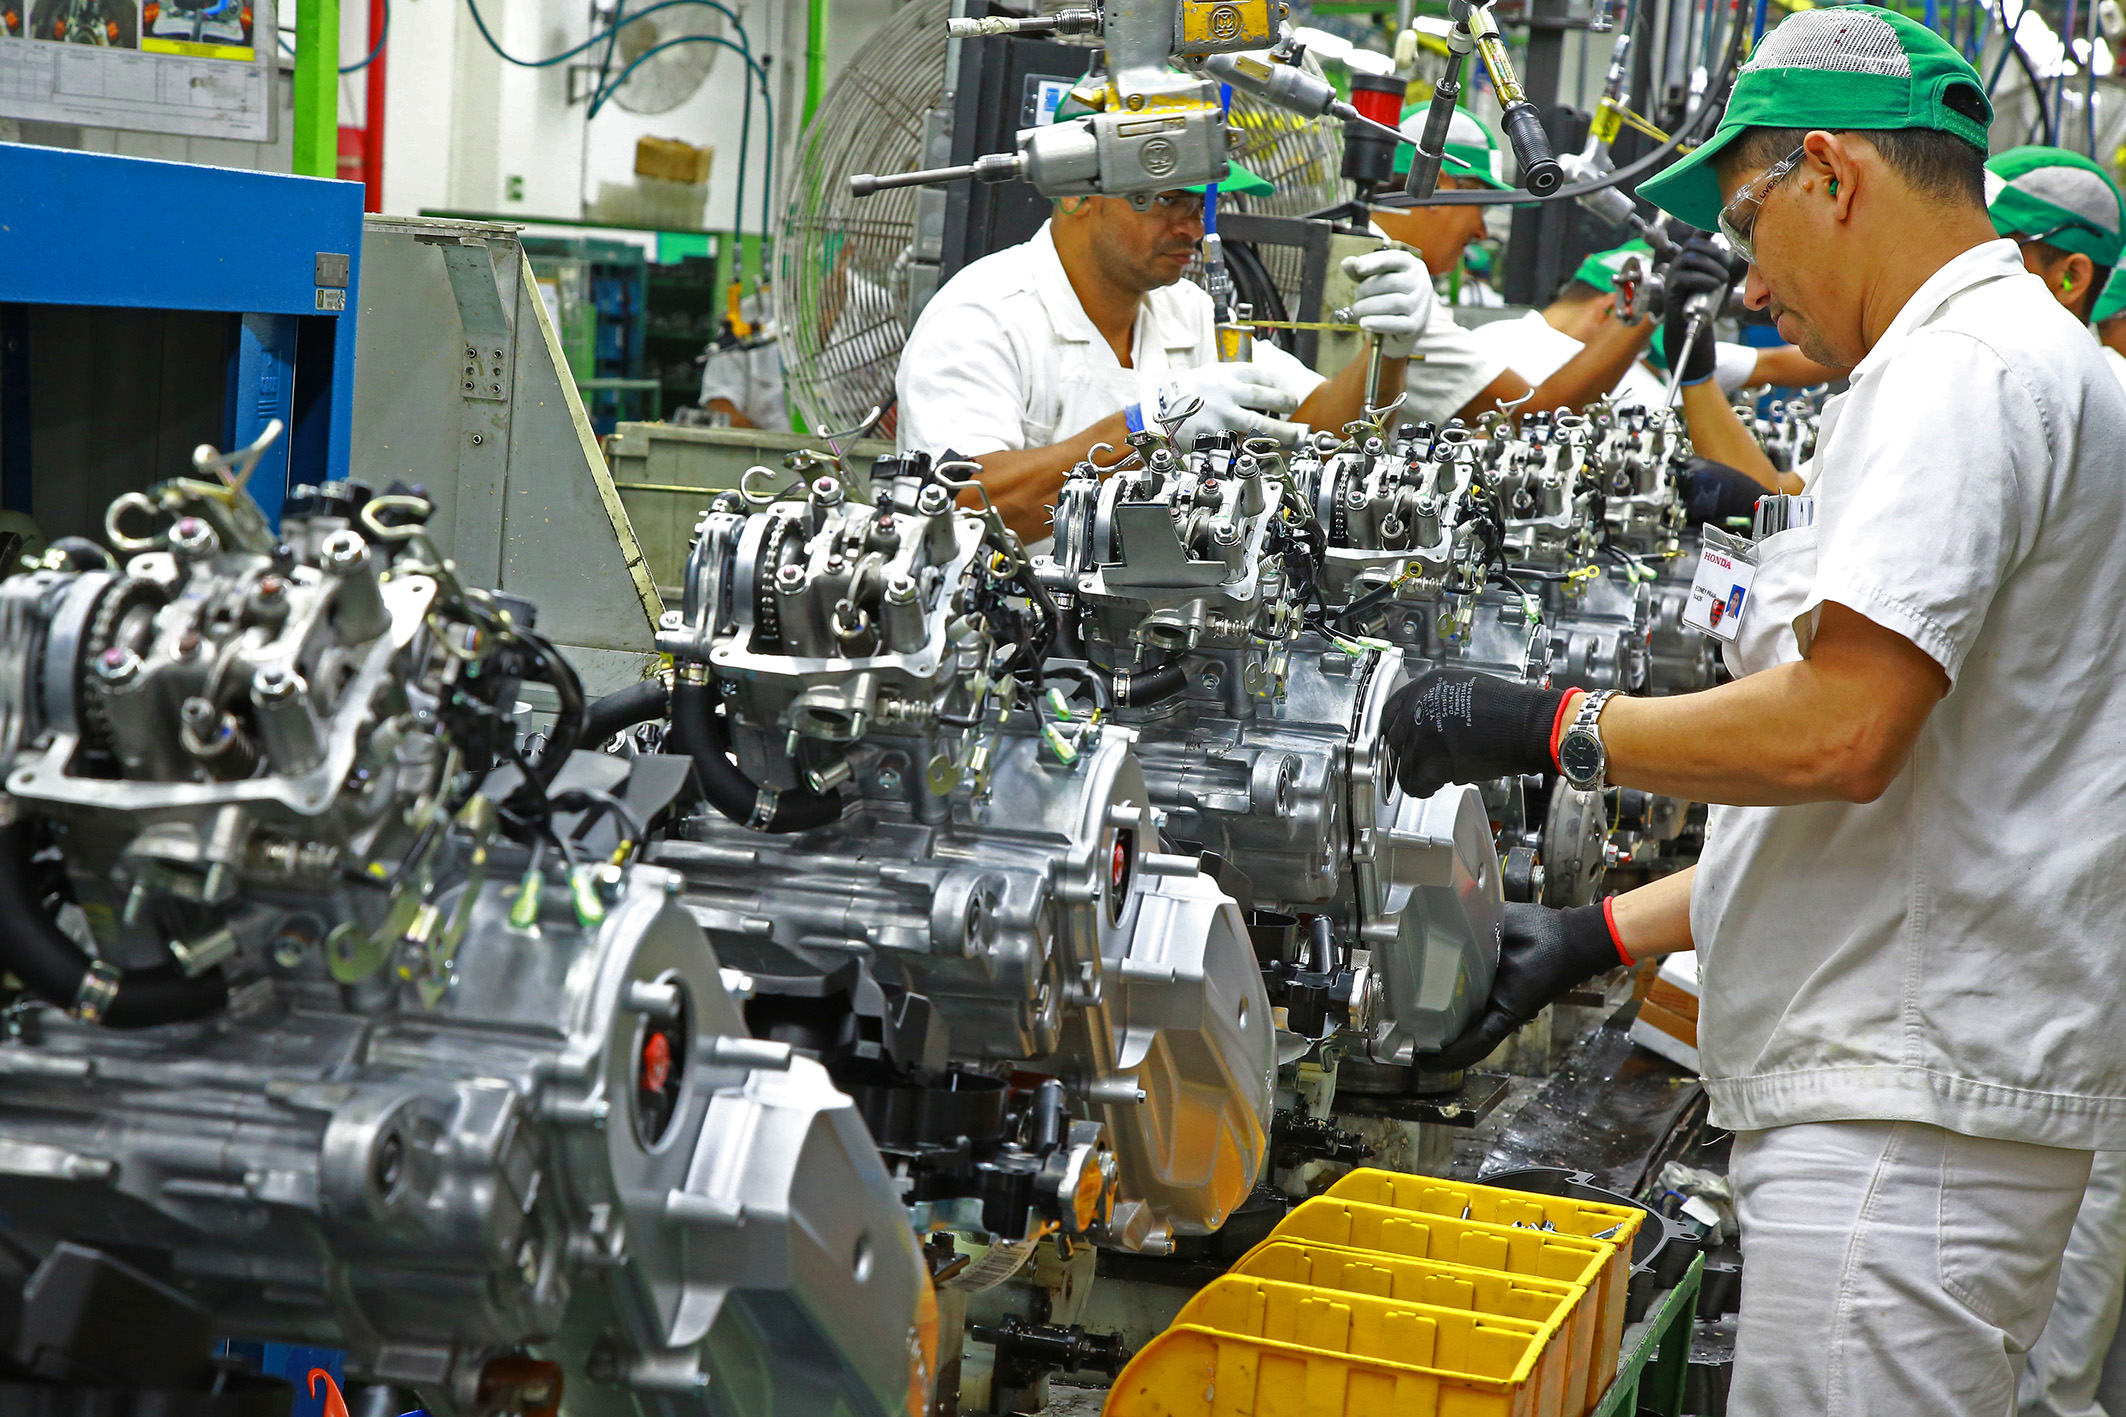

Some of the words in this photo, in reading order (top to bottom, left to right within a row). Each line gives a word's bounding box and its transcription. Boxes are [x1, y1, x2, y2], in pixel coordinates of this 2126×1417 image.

[1759, 177, 1777, 198] UVEX
[1704, 552, 1731, 569] HONDA
[1428, 687, 1436, 721] YELING
